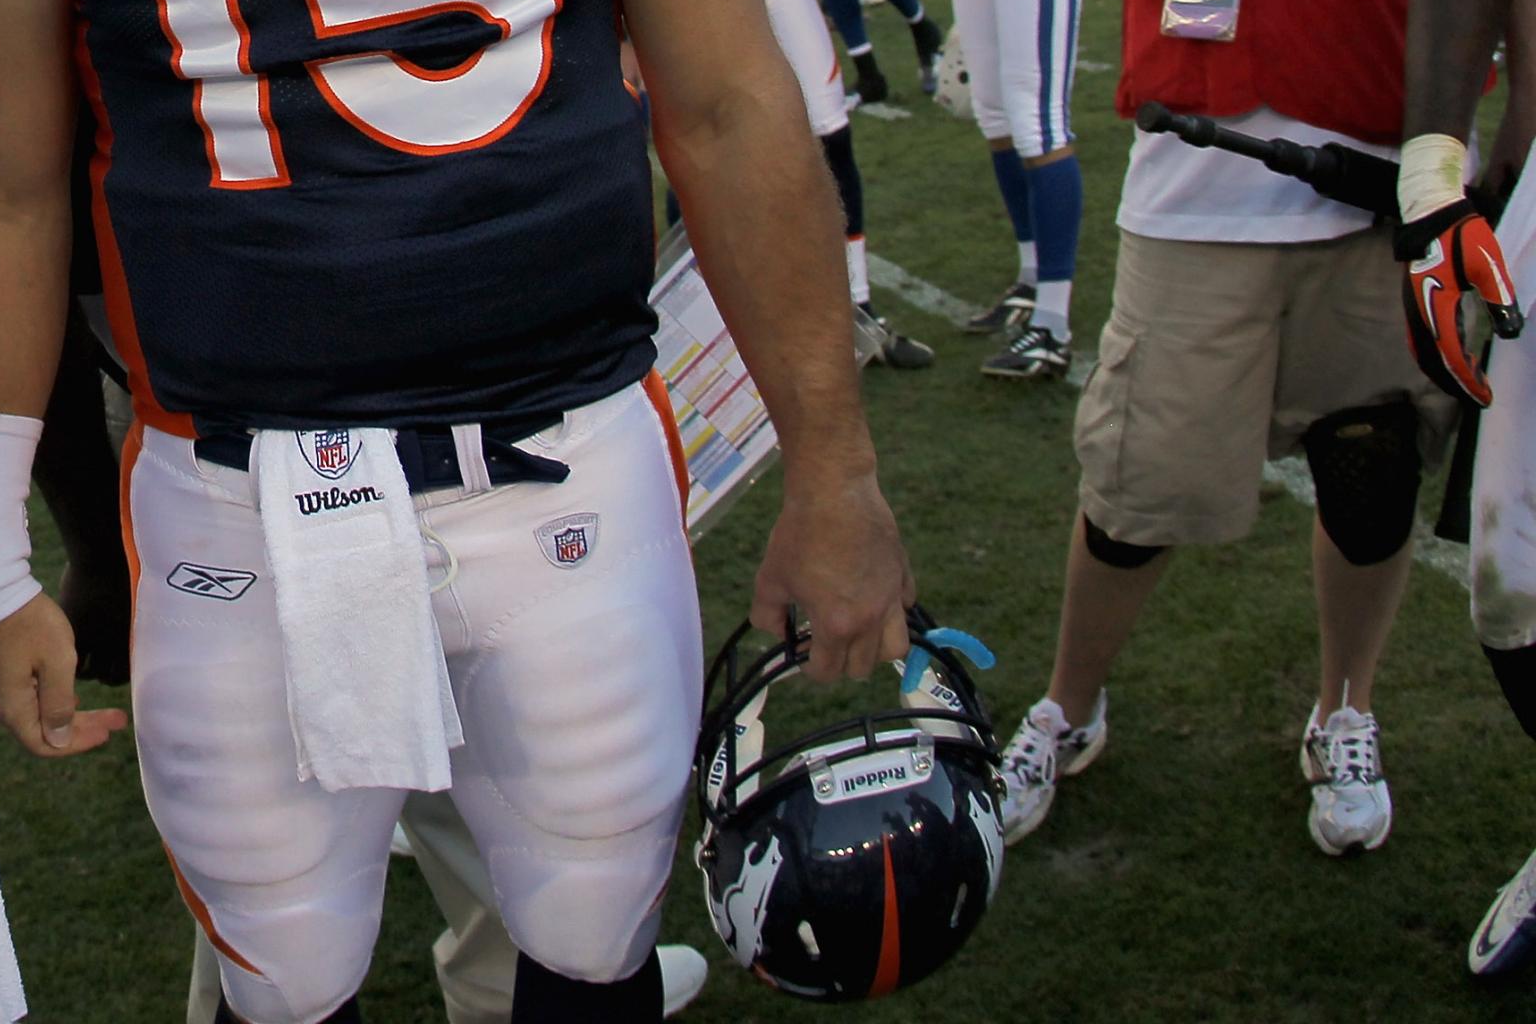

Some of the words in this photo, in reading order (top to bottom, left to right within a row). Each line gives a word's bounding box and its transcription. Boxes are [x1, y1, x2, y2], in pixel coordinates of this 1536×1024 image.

[319, 444, 347, 469] NFL
[295, 487, 380, 515] Wilson
[560, 542, 586, 560] NFL
[844, 766, 906, 792] Riddell
